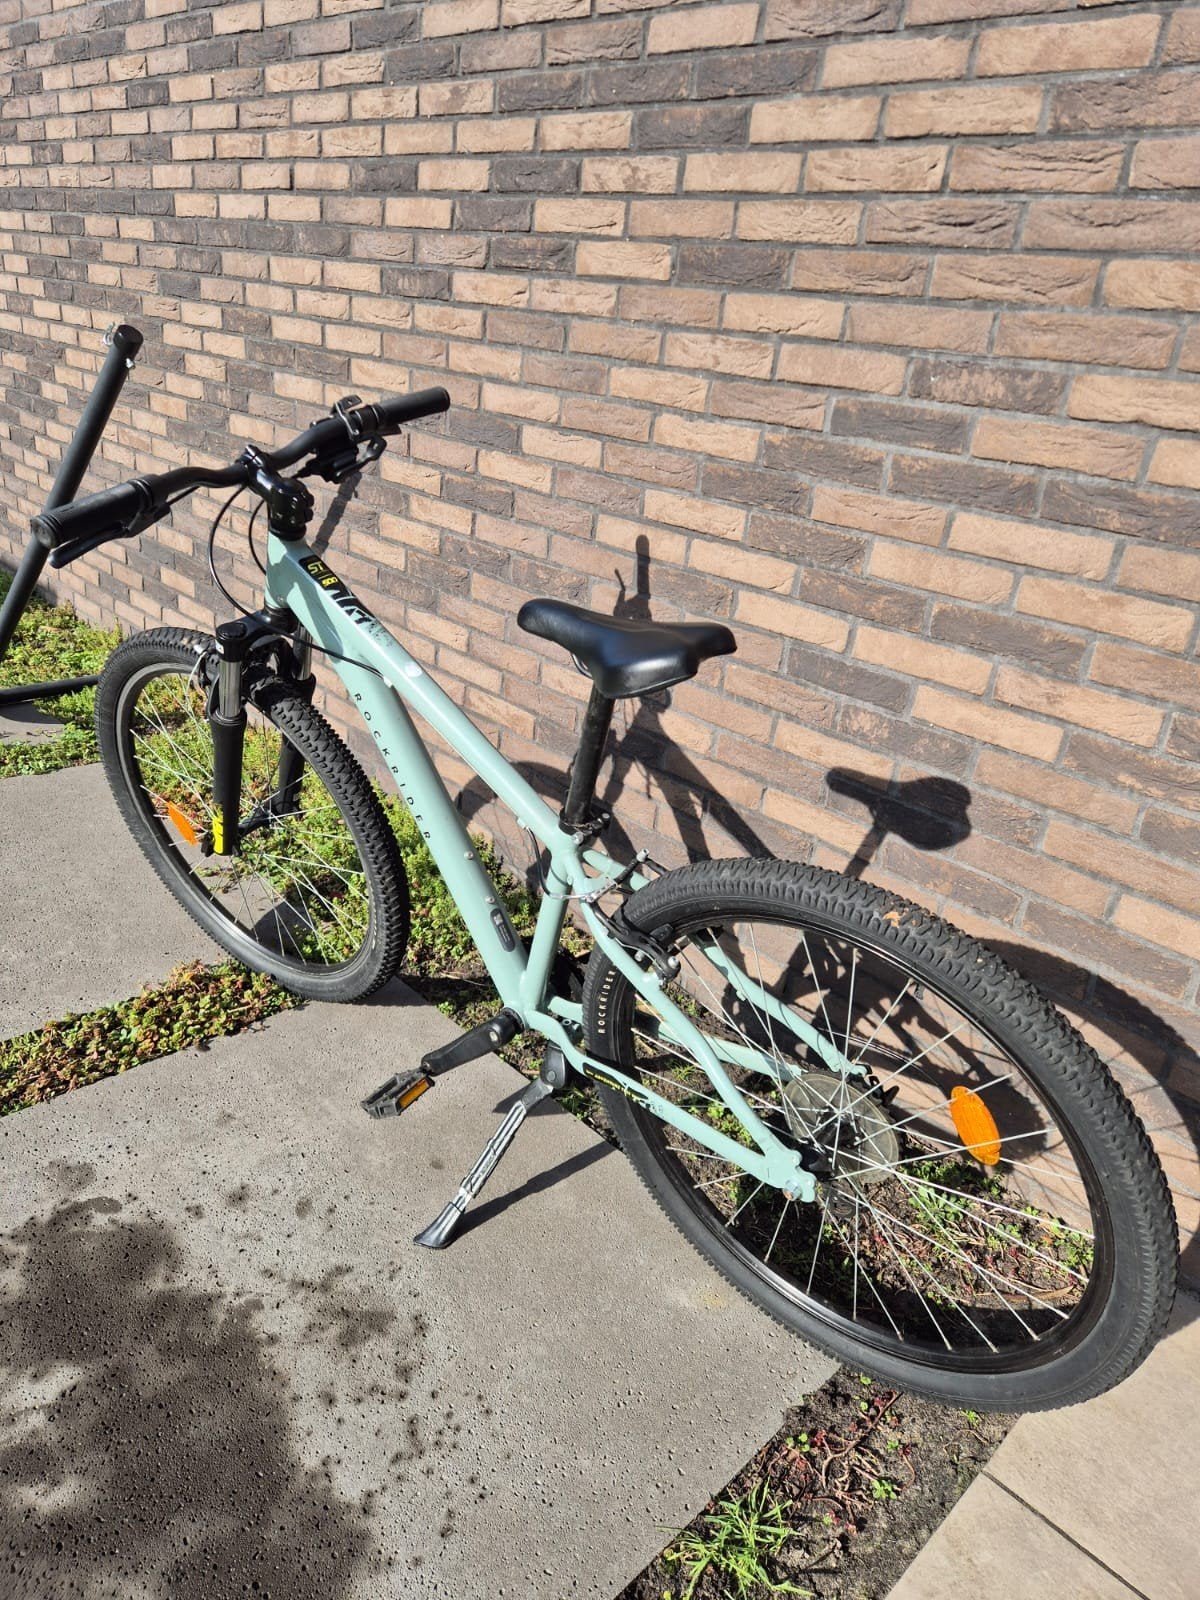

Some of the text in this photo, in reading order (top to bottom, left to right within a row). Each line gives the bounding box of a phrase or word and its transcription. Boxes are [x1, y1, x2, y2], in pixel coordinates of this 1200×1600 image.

[307, 561, 324, 574] ST
[354, 693, 431, 839] ROCKRIDER
[597, 970, 617, 1034] ROCKRIDER
